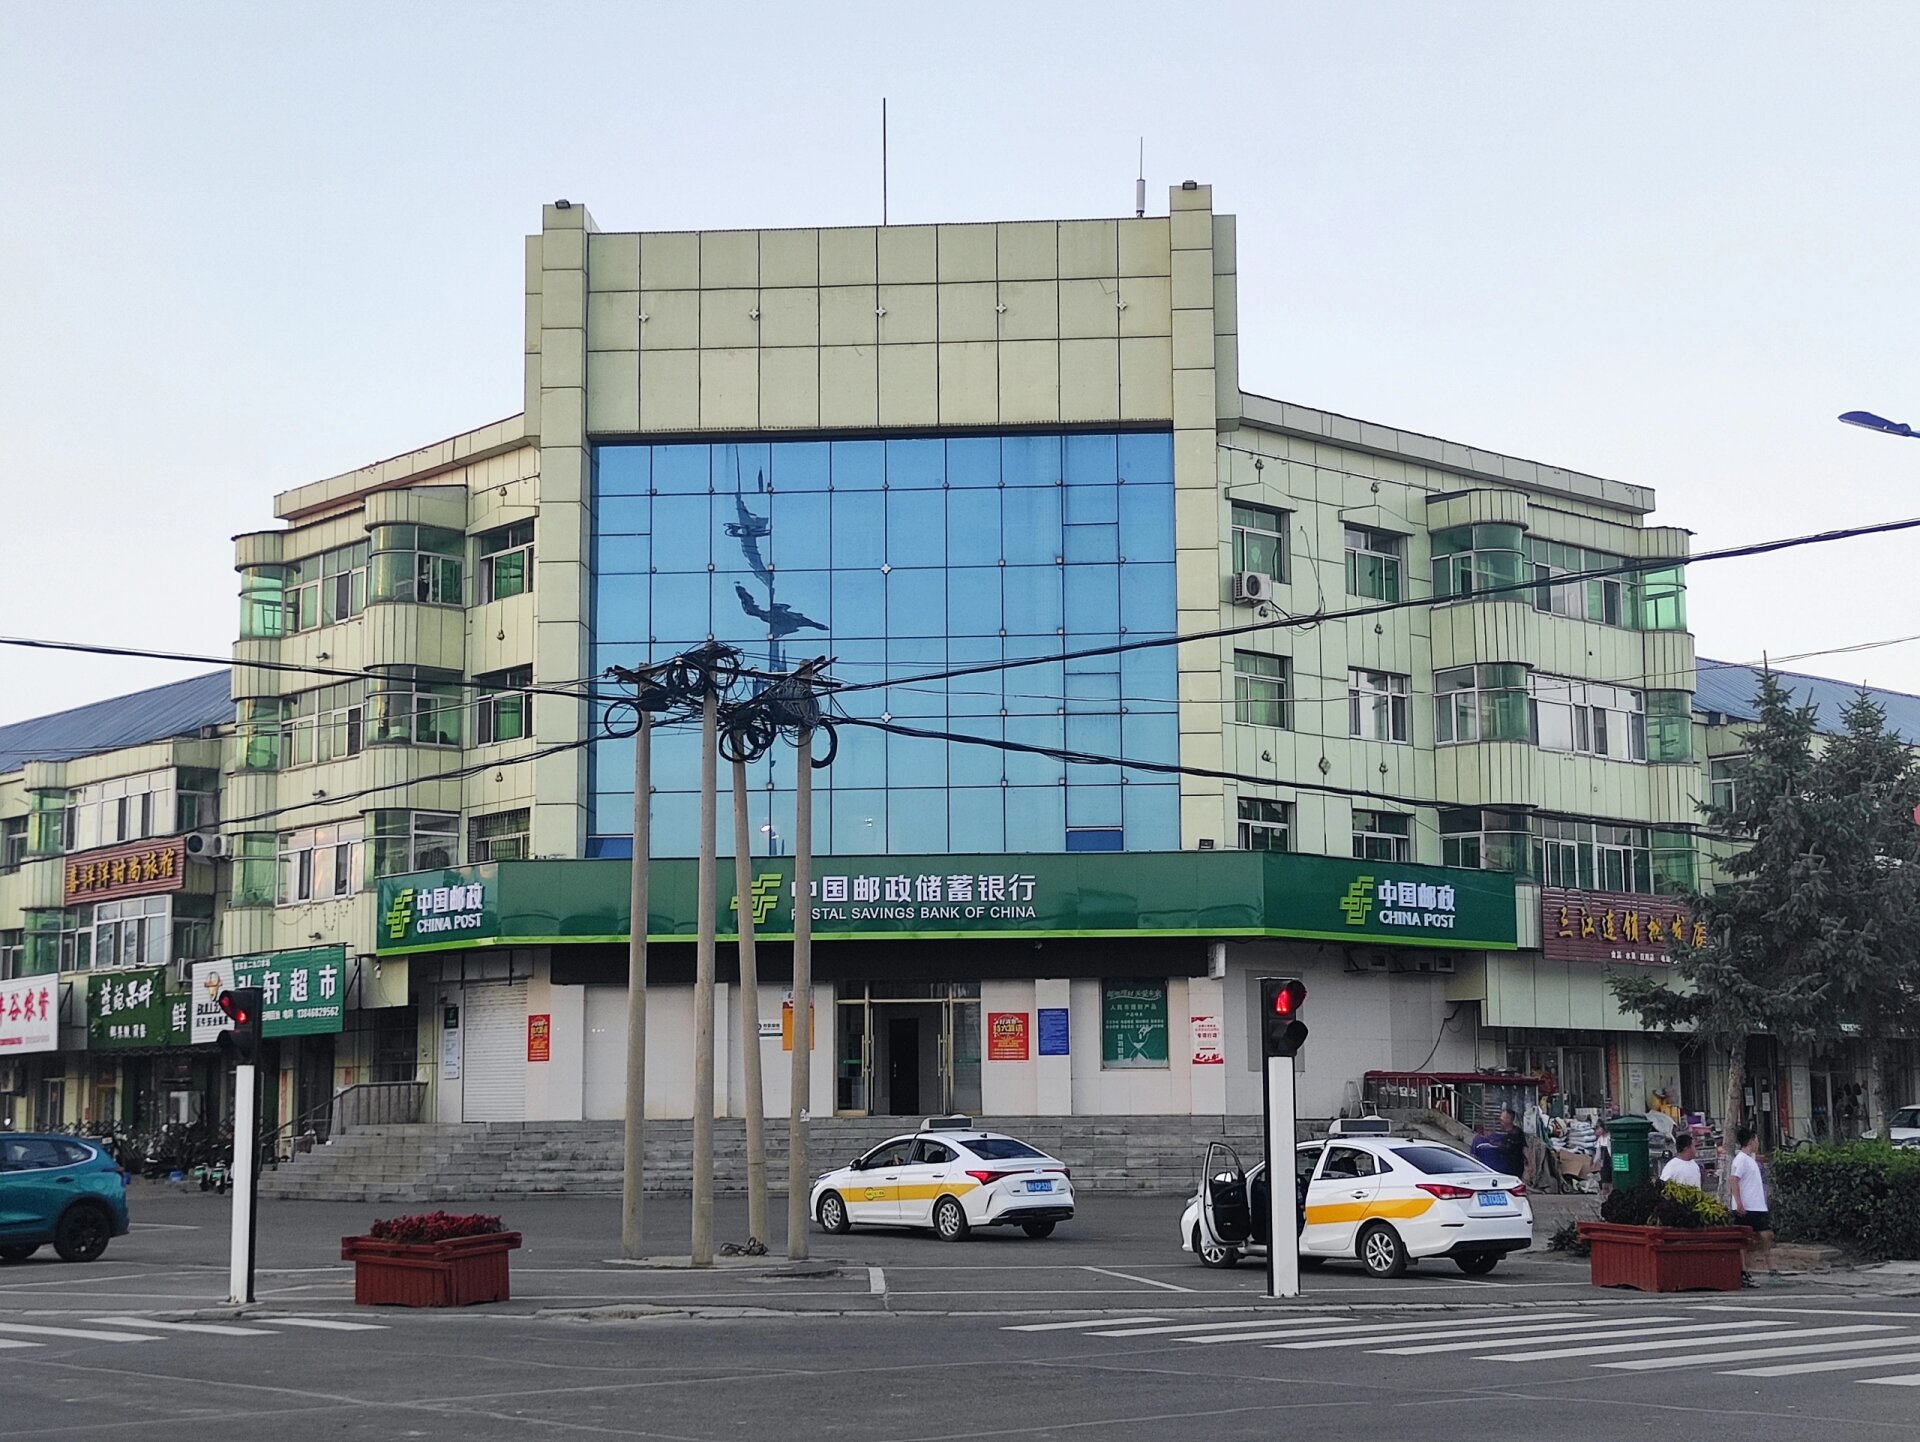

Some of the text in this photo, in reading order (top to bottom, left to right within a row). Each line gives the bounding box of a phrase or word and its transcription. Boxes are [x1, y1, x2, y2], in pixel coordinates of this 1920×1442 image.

[416, 882, 483, 916] 中国邮政
[1378, 880, 1456, 911] 中国邮政
[416, 913, 483, 933] CHINA POST
[791, 906, 1036, 920] STAL SAVINGS BANK OF CHINA
[1379, 910, 1456, 929] CHINA POST
[172, 1002, 187, 1032] 鲜
